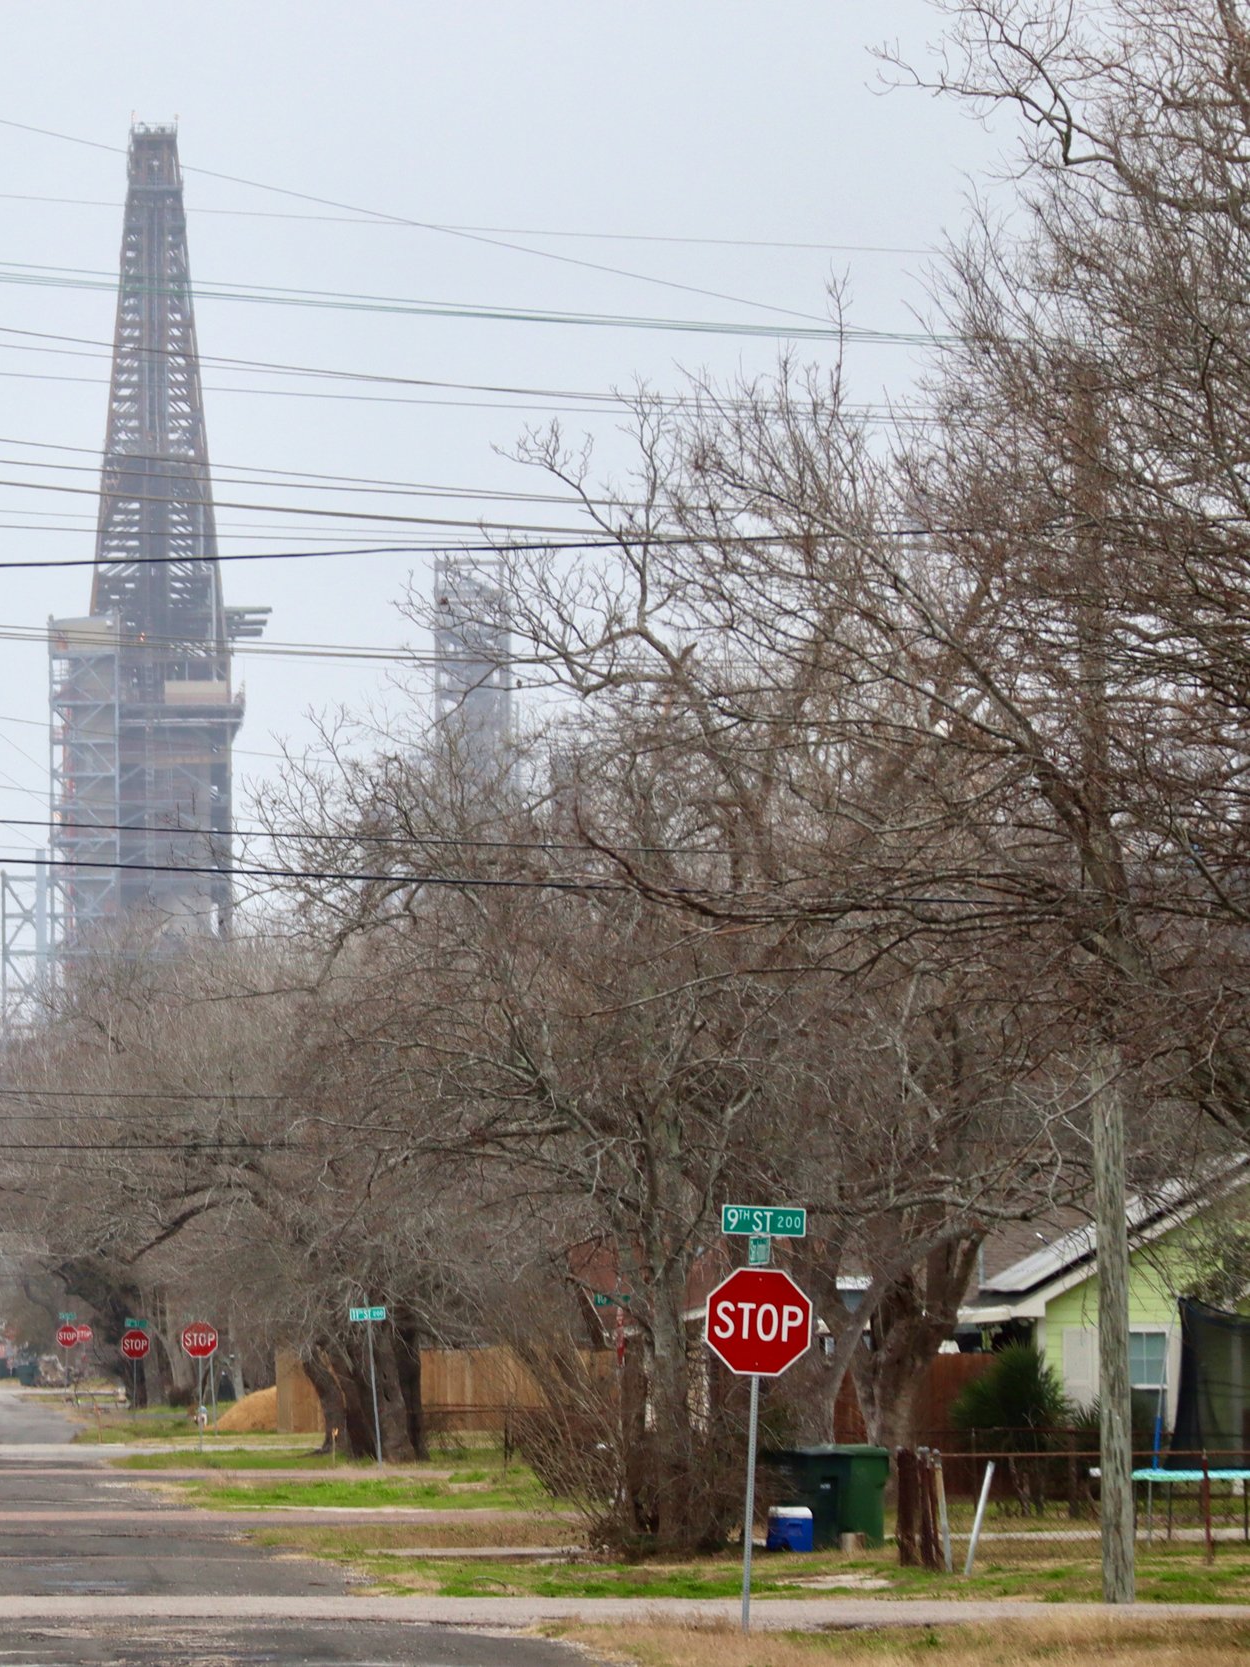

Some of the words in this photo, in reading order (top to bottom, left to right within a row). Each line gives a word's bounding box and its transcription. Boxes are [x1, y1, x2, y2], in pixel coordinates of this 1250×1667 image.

[727, 1209, 750, 1230] 9TH
[752, 1211, 774, 1232] ST
[777, 1216, 801, 1229] 200
[714, 1300, 804, 1342] STOP
[58, 1331, 77, 1341] STOP
[184, 1333, 215, 1347] STOP
[123, 1338, 148, 1351] STOP
